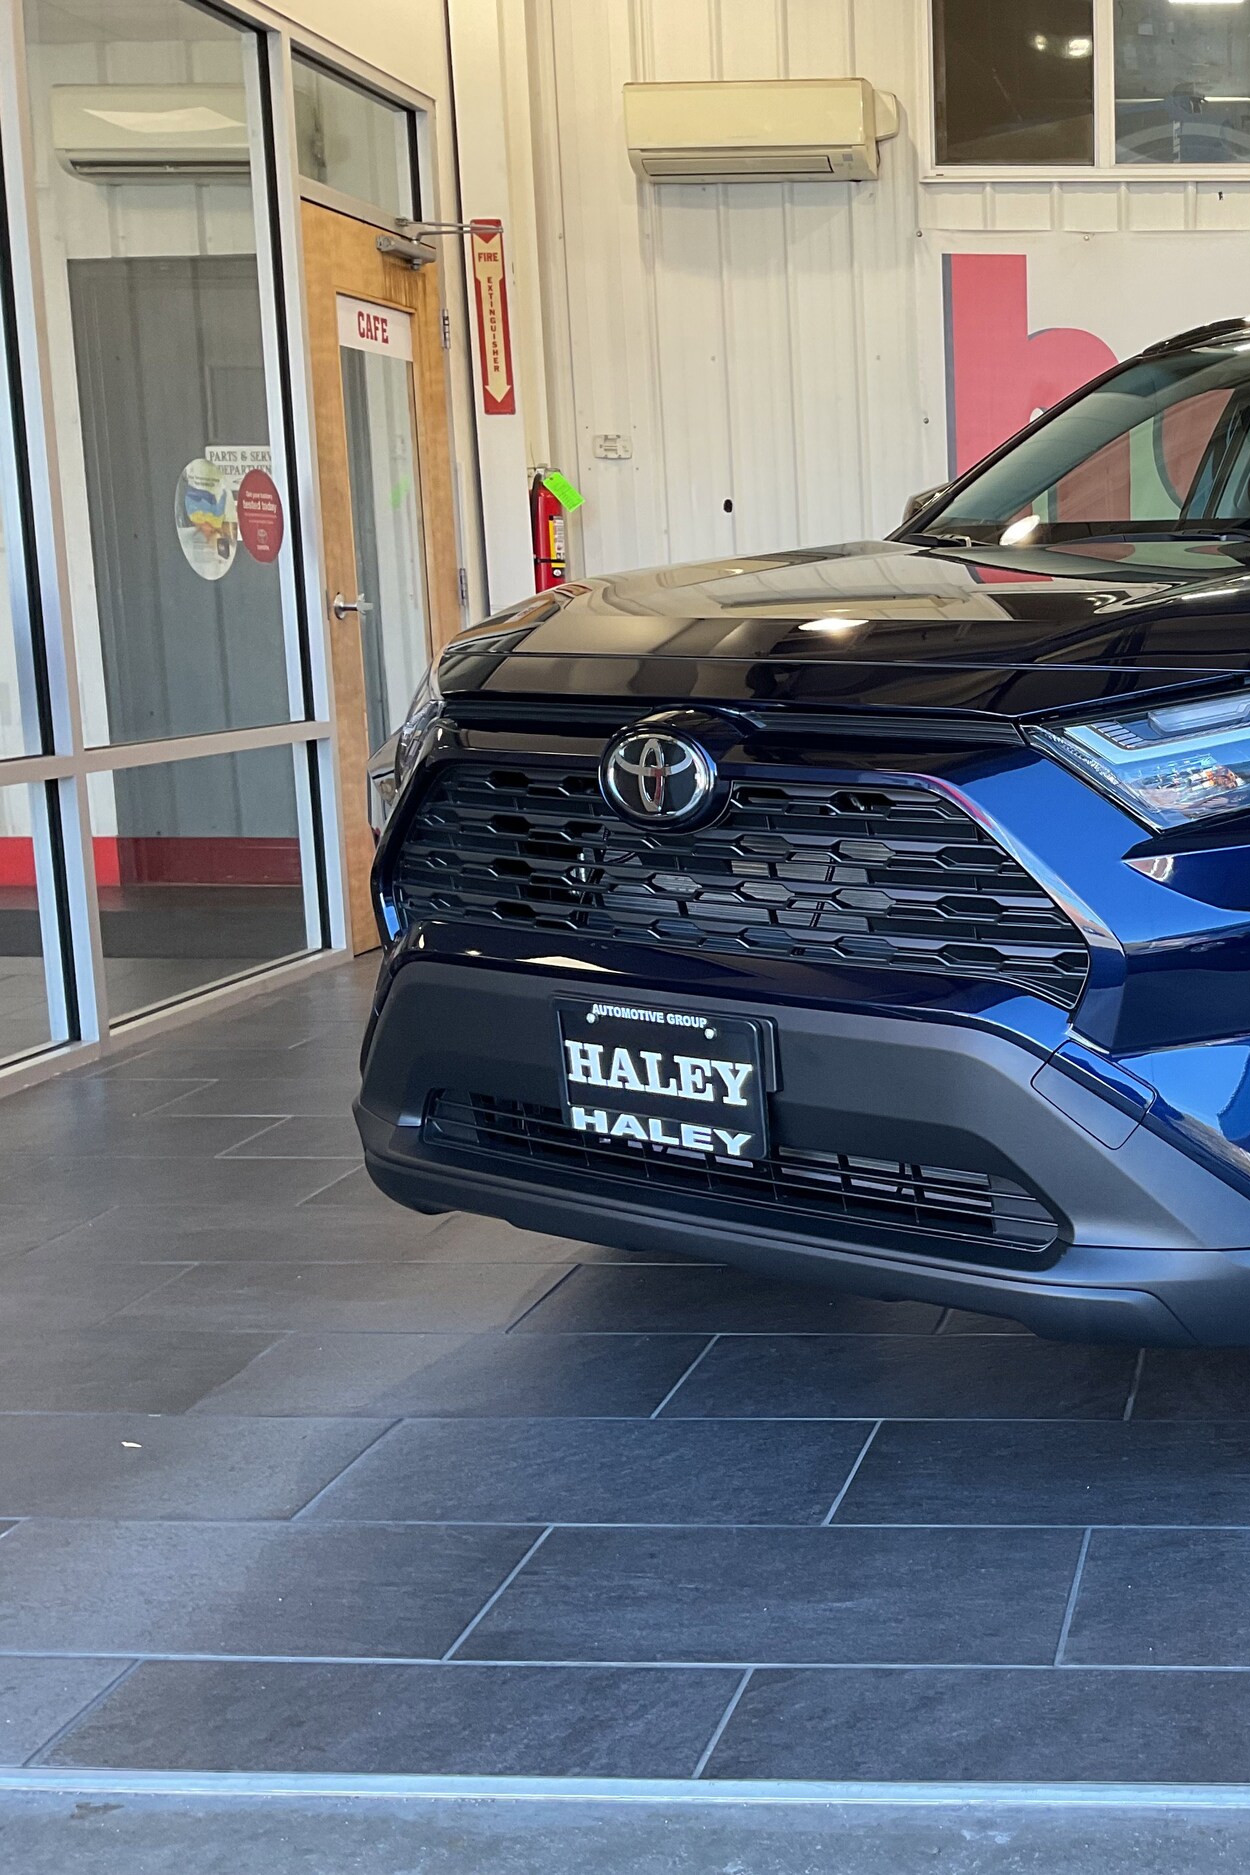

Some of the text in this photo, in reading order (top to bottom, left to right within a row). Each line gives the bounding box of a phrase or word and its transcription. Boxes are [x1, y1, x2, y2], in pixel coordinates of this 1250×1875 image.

[478, 252, 499, 262] FIRE
[357, 310, 389, 345] CAFE
[487, 276, 500, 372] EXTINGUISHER
[209, 450, 238, 462] PARTS
[240, 450, 248, 462] &
[261, 501, 277, 514] today
[592, 1003, 708, 1028] AUTOMOTIVE GROUP
[564, 1039, 753, 1106] HALEY
[571, 1106, 752, 1156] HALEY
